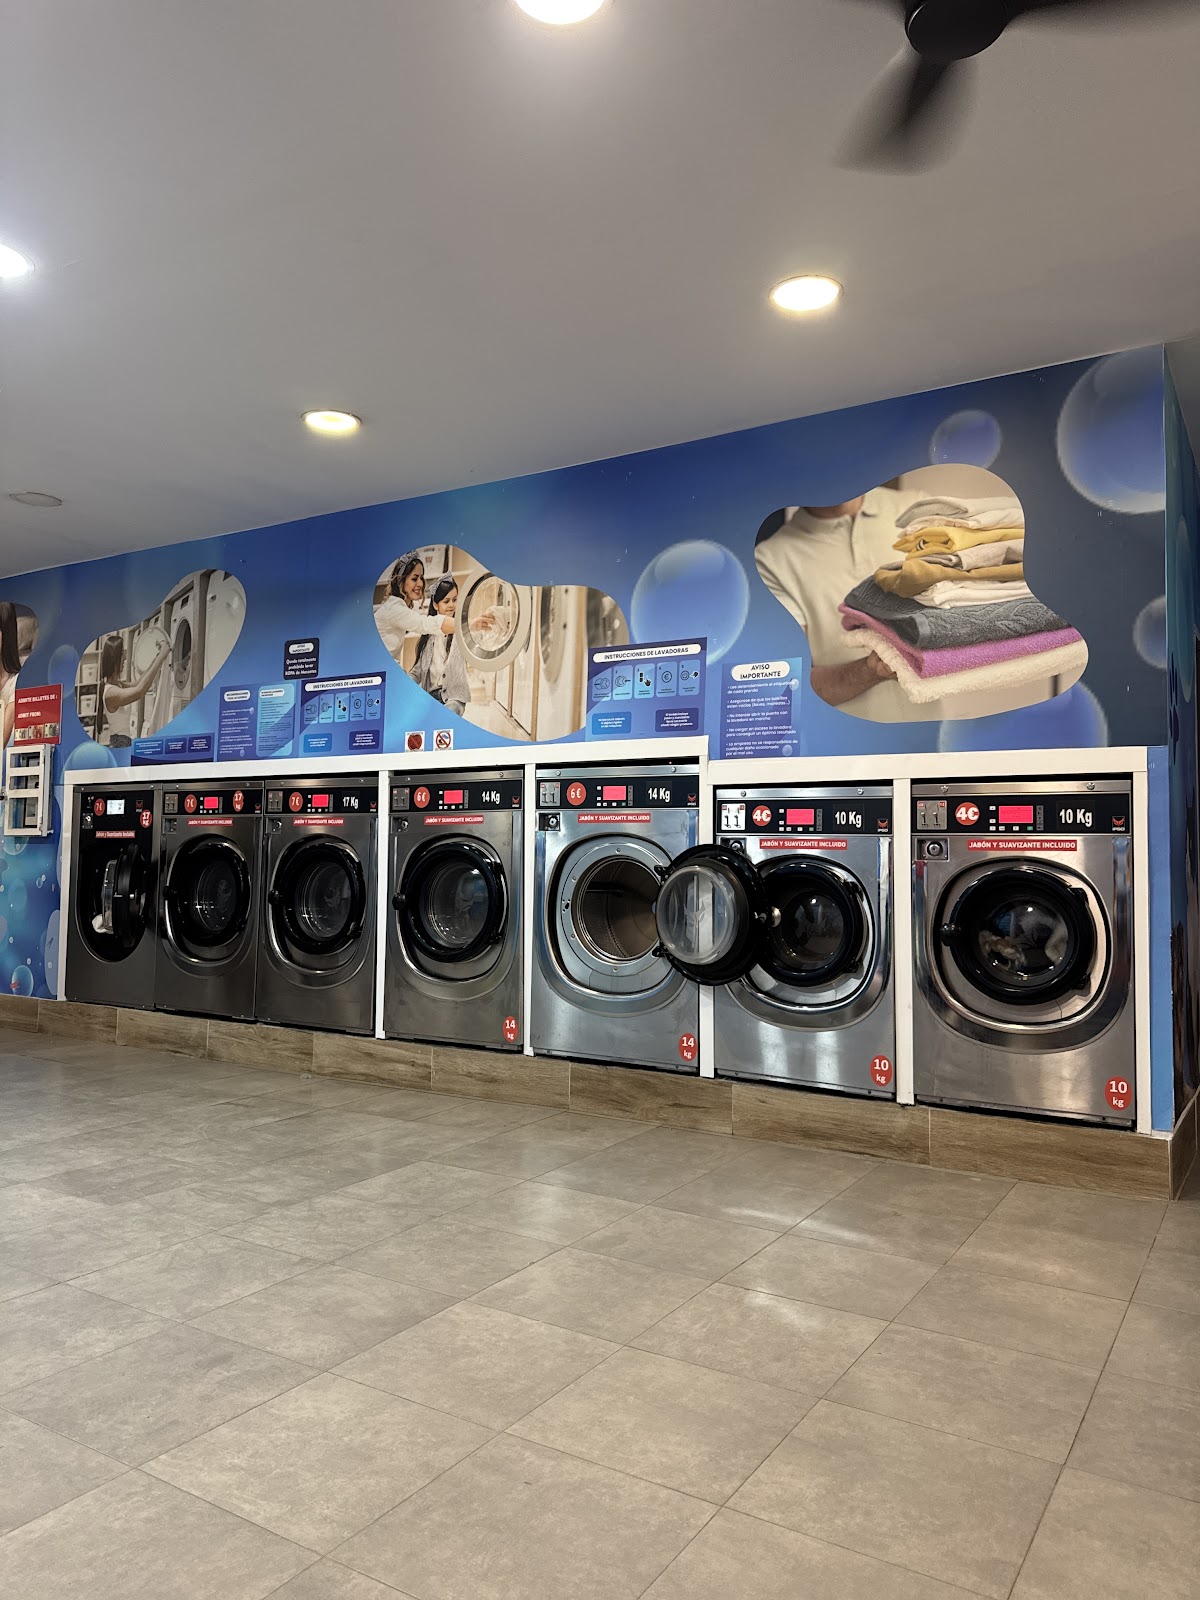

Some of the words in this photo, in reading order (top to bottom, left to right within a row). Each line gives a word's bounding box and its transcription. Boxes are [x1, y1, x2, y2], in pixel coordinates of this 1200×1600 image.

[604, 652, 646, 660] INSTRUCCIONES
[740, 671, 781, 679] IMPORTANTE
[482, 791, 490, 802] 14
[491, 791, 500, 804] Kg
[648, 788, 657, 800] 14
[659, 788, 670, 802] Kg
[343, 797, 350, 807] 17
[351, 796, 359, 809] Kg
[753, 810, 772, 822] 4€
[956, 806, 979, 820] 4€
[1059, 809, 1073, 824] 10
[1077, 808, 1093, 827] Kg
[835, 812, 846, 824] 10
[849, 811, 862, 828] Kg
[505, 1020, 515, 1029] 14
[507, 1032, 514, 1040] kg
[682, 1036, 694, 1047] 14
[684, 1050, 692, 1059] kg
[874, 1059, 889, 1071] 10
[876, 1074, 886, 1084] kg
[1109, 1081, 1128, 1094] 10
[1113, 1097, 1124, 1108] kg
